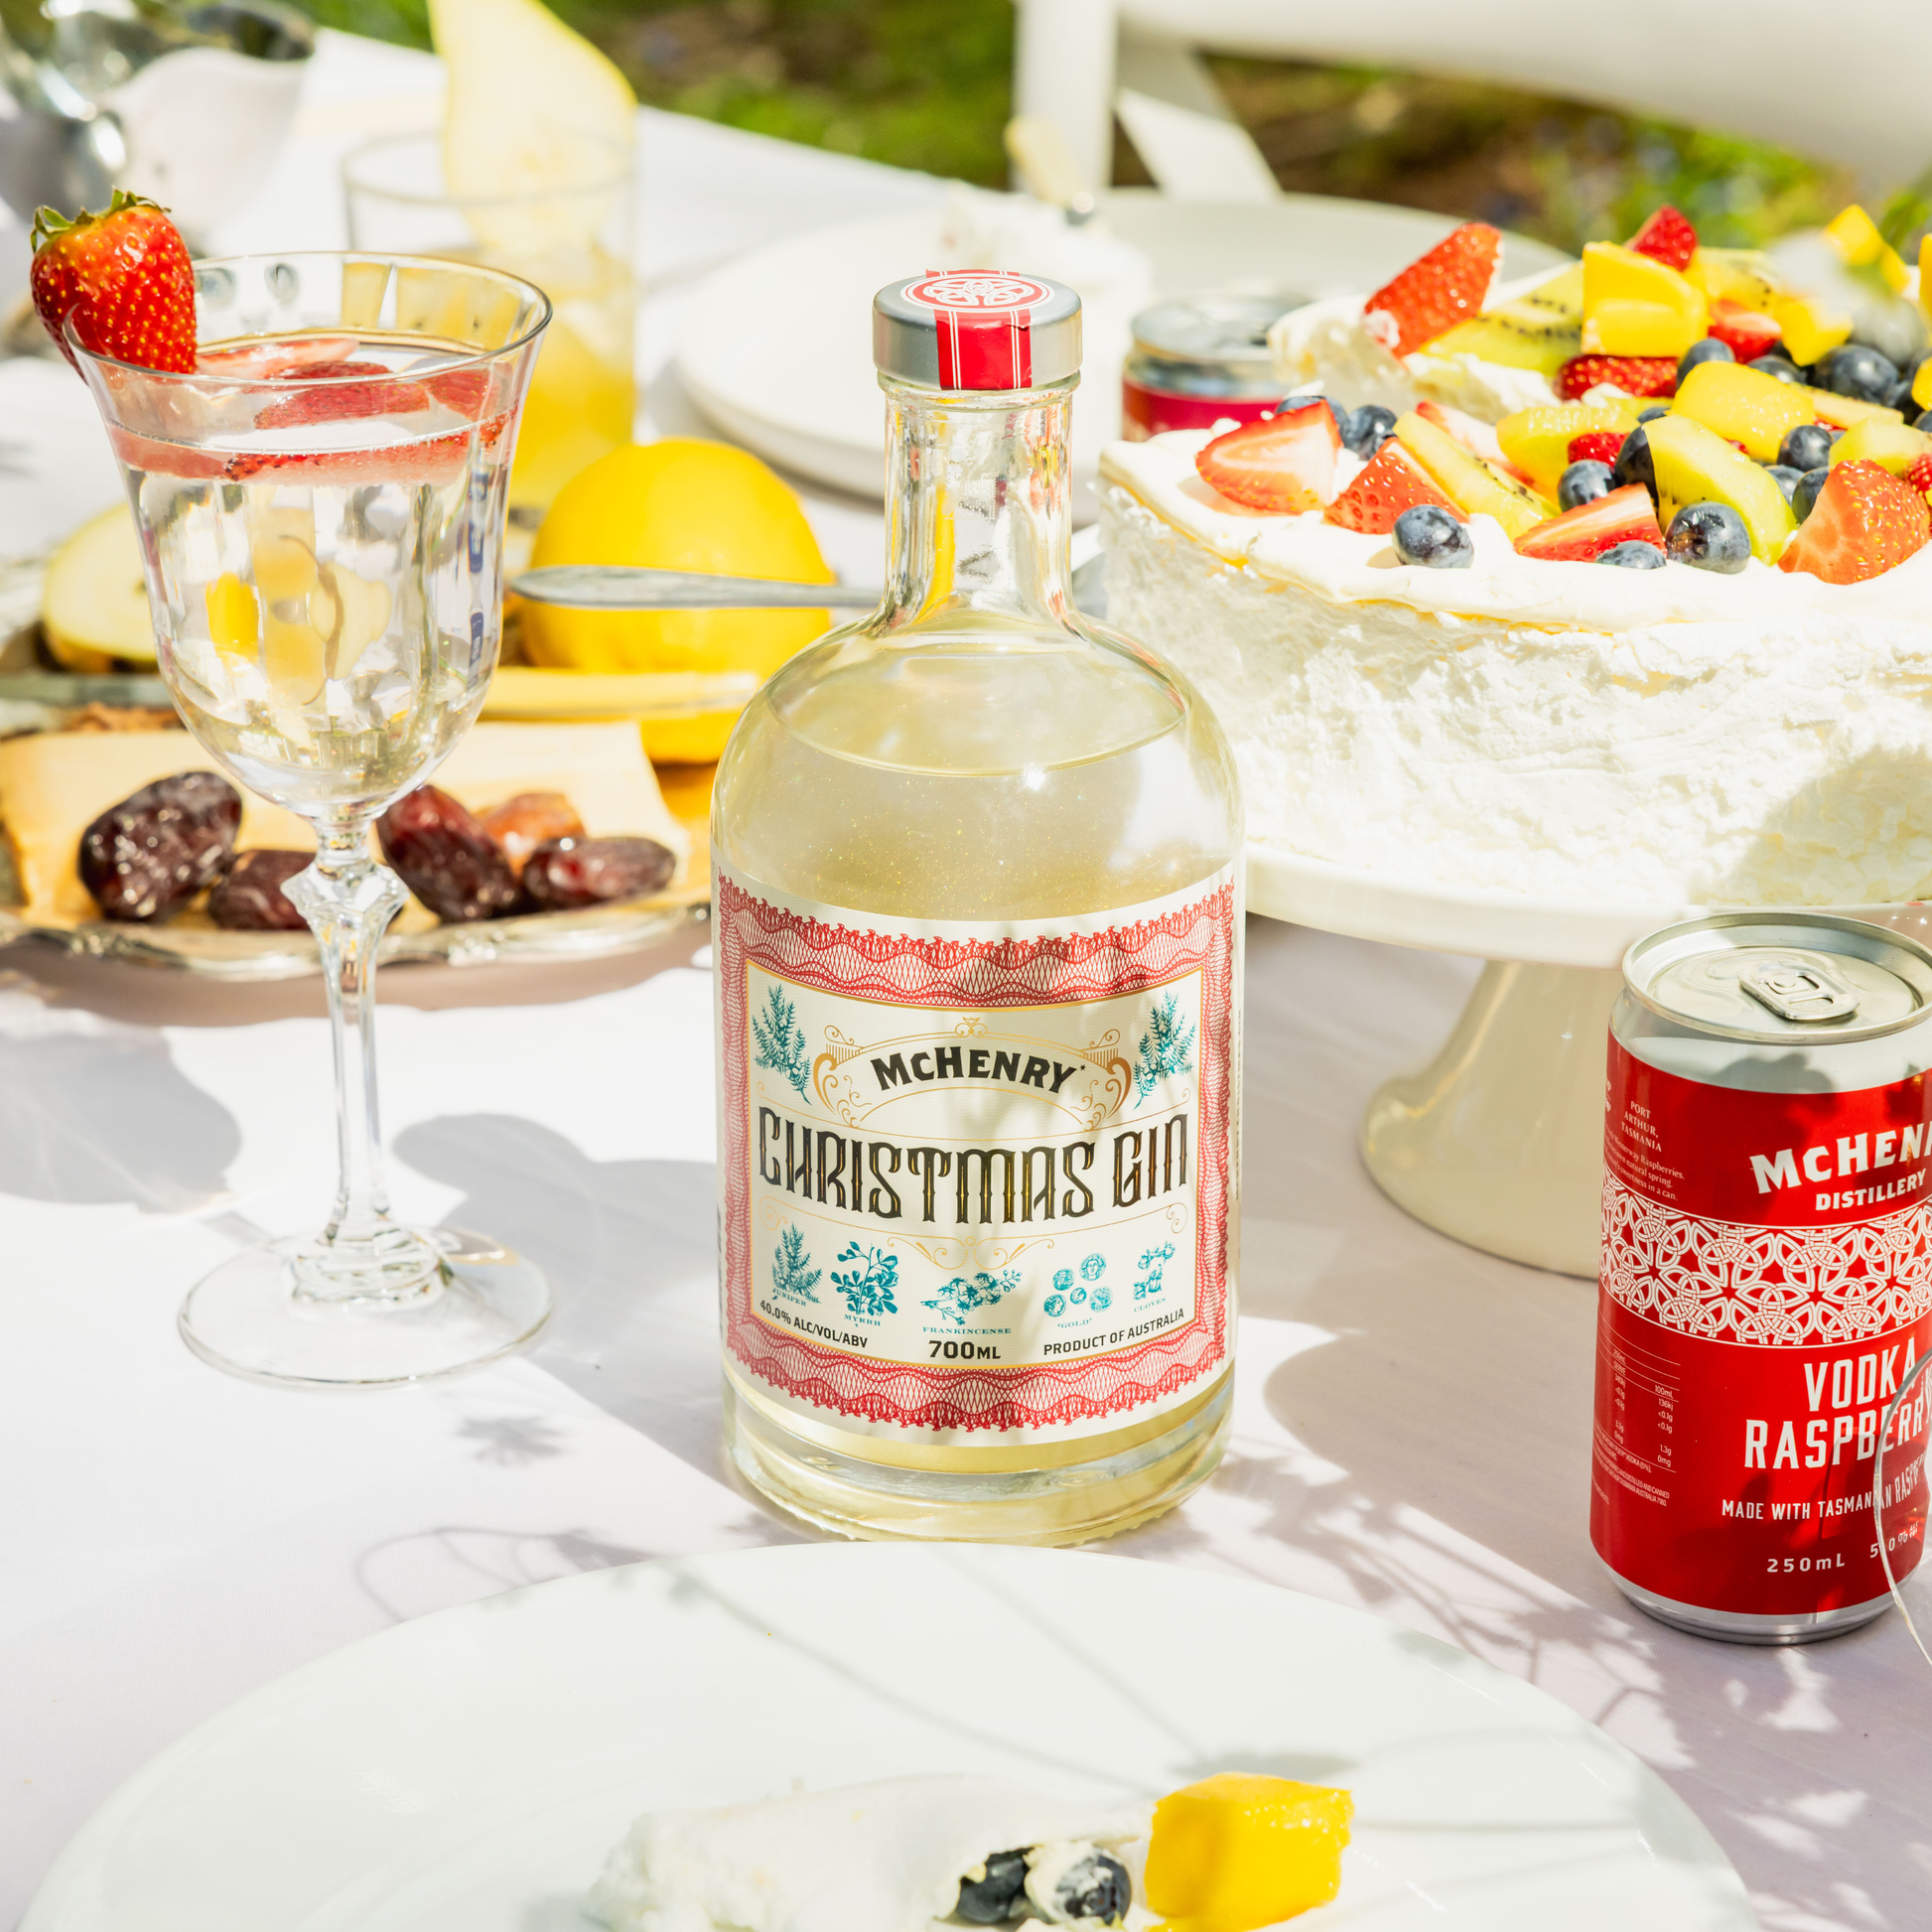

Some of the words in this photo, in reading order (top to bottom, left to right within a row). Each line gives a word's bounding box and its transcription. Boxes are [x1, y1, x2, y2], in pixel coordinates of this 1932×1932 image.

[1630, 1100, 1651, 1119] PORT
[1623, 1111, 1659, 1139] ARTHUR,
[1621, 1121, 1662, 1153] TASMANIA
[758, 1105, 1096, 1224] CHRISTMAS
[1111, 1113, 1189, 1208] GIN
[1625, 1159, 1647, 1176] natural
[1640, 1154, 1686, 1180] Raspberries.
[1648, 1181, 1656, 1192] in
[1661, 1189, 1679, 1201] can.
[1815, 1168, 1927, 1211] DISTILLERY
[1133, 1297, 1167, 1313] CLOVES
[759, 1300, 791, 1324] 40.0%
[793, 1315, 869, 1348] ALC/VOL/ABV
[844, 1313, 881, 1326] MYRRH
[1043, 1334, 1107, 1356] PRODUCT
[1109, 1329, 1126, 1344] OF
[1127, 1308, 1184, 1340] AUSTRALIA
[1804, 1336, 1916, 1412] VODKA
[1654, 1385, 1674, 1399] 100mL
[1657, 1411, 1673, 1423] <0.1g
[1657, 1422, 1673, 1434] <0.1g
[1659, 1445, 1672, 1456] 1.3g
[1657, 1454, 1672, 1468] 0mg
[1722, 1498, 1764, 1520] MADE
[1771, 1502, 1811, 1521] WITH
[1766, 1553, 1846, 1574] 250mL
